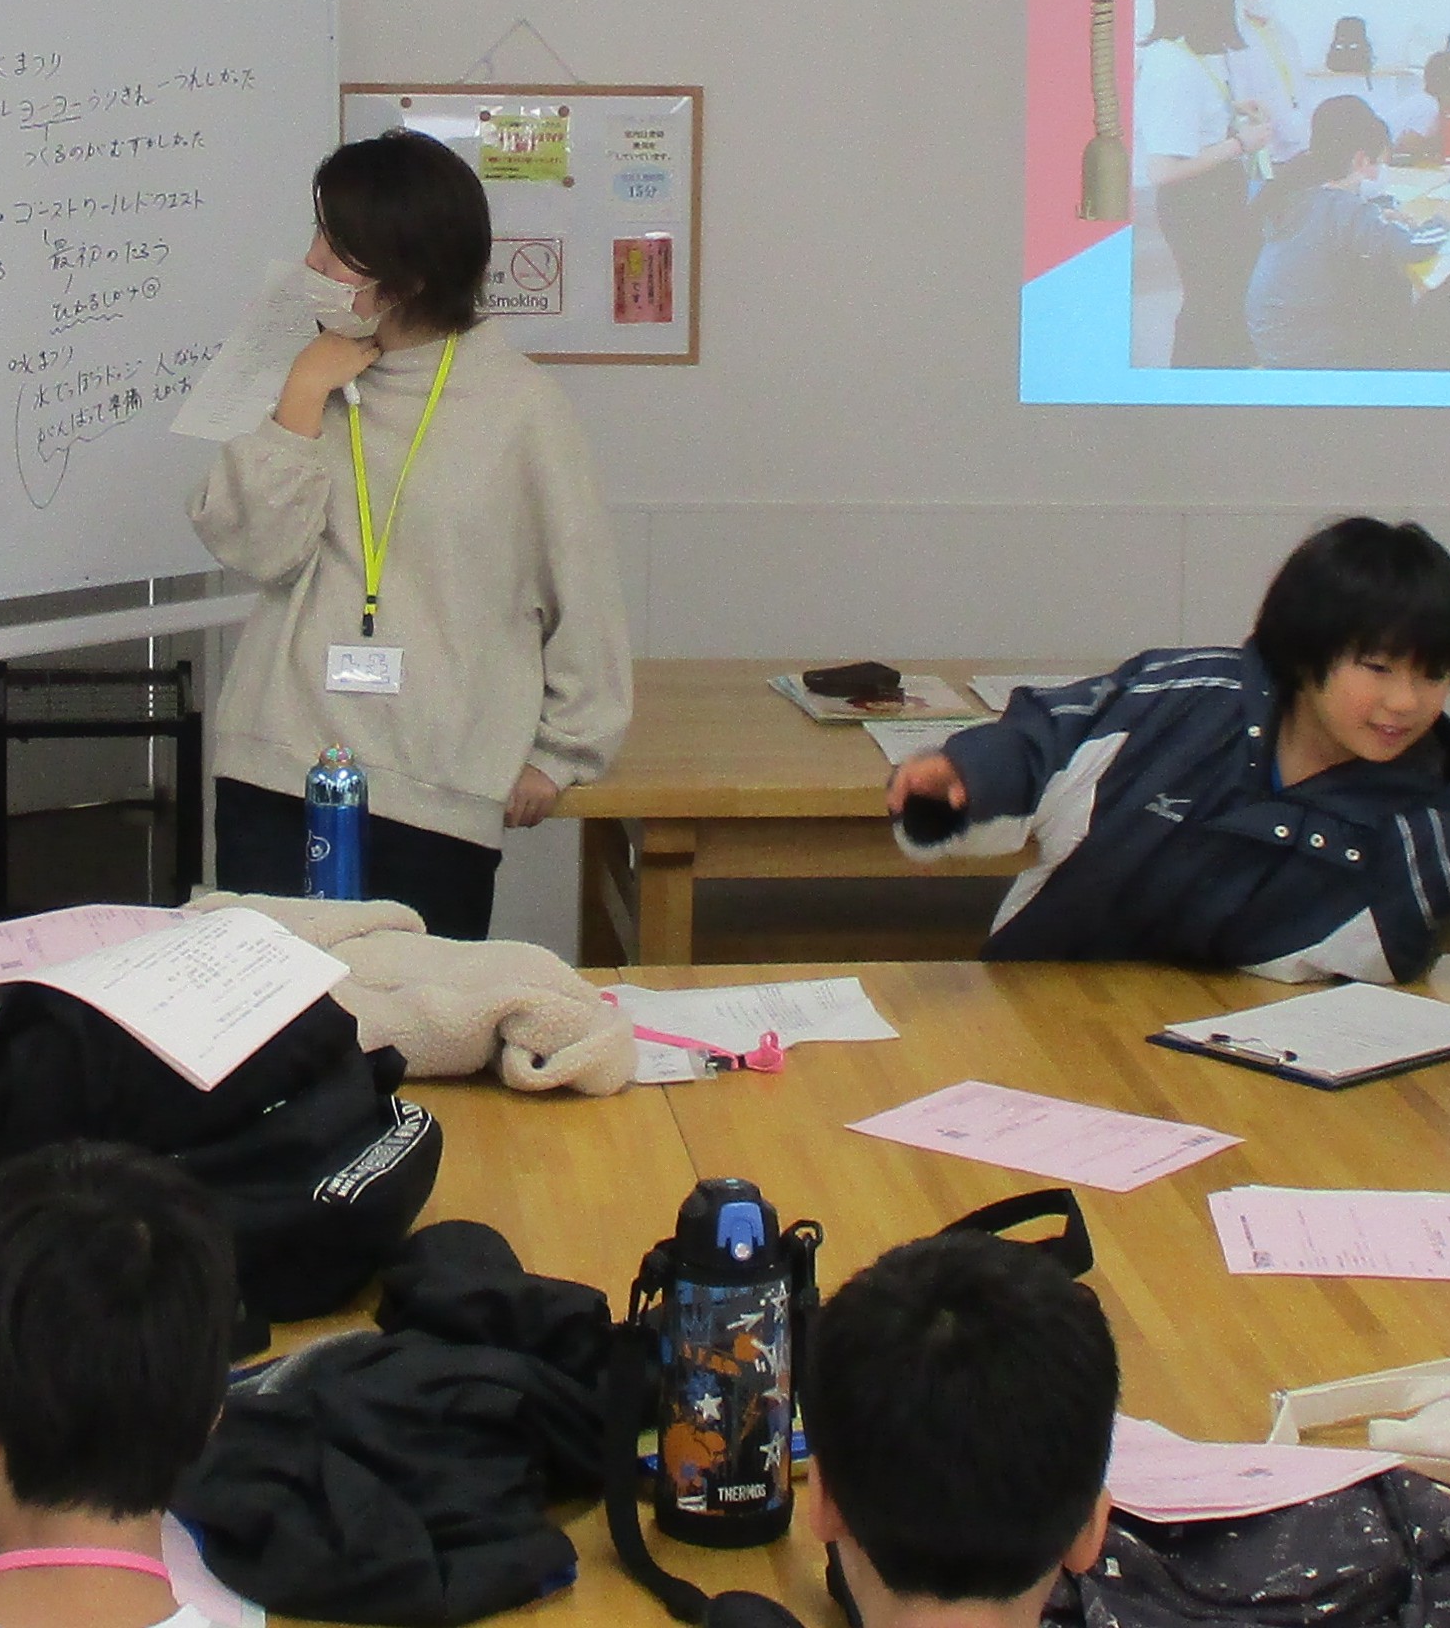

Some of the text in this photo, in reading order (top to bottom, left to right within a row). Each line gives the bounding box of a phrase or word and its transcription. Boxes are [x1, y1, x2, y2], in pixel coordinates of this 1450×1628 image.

[13, 187, 206, 225] ゴーストワールドクエスト
[489, 293, 549, 310] Smoking
[716, 1482, 768, 1503] THERMOS
